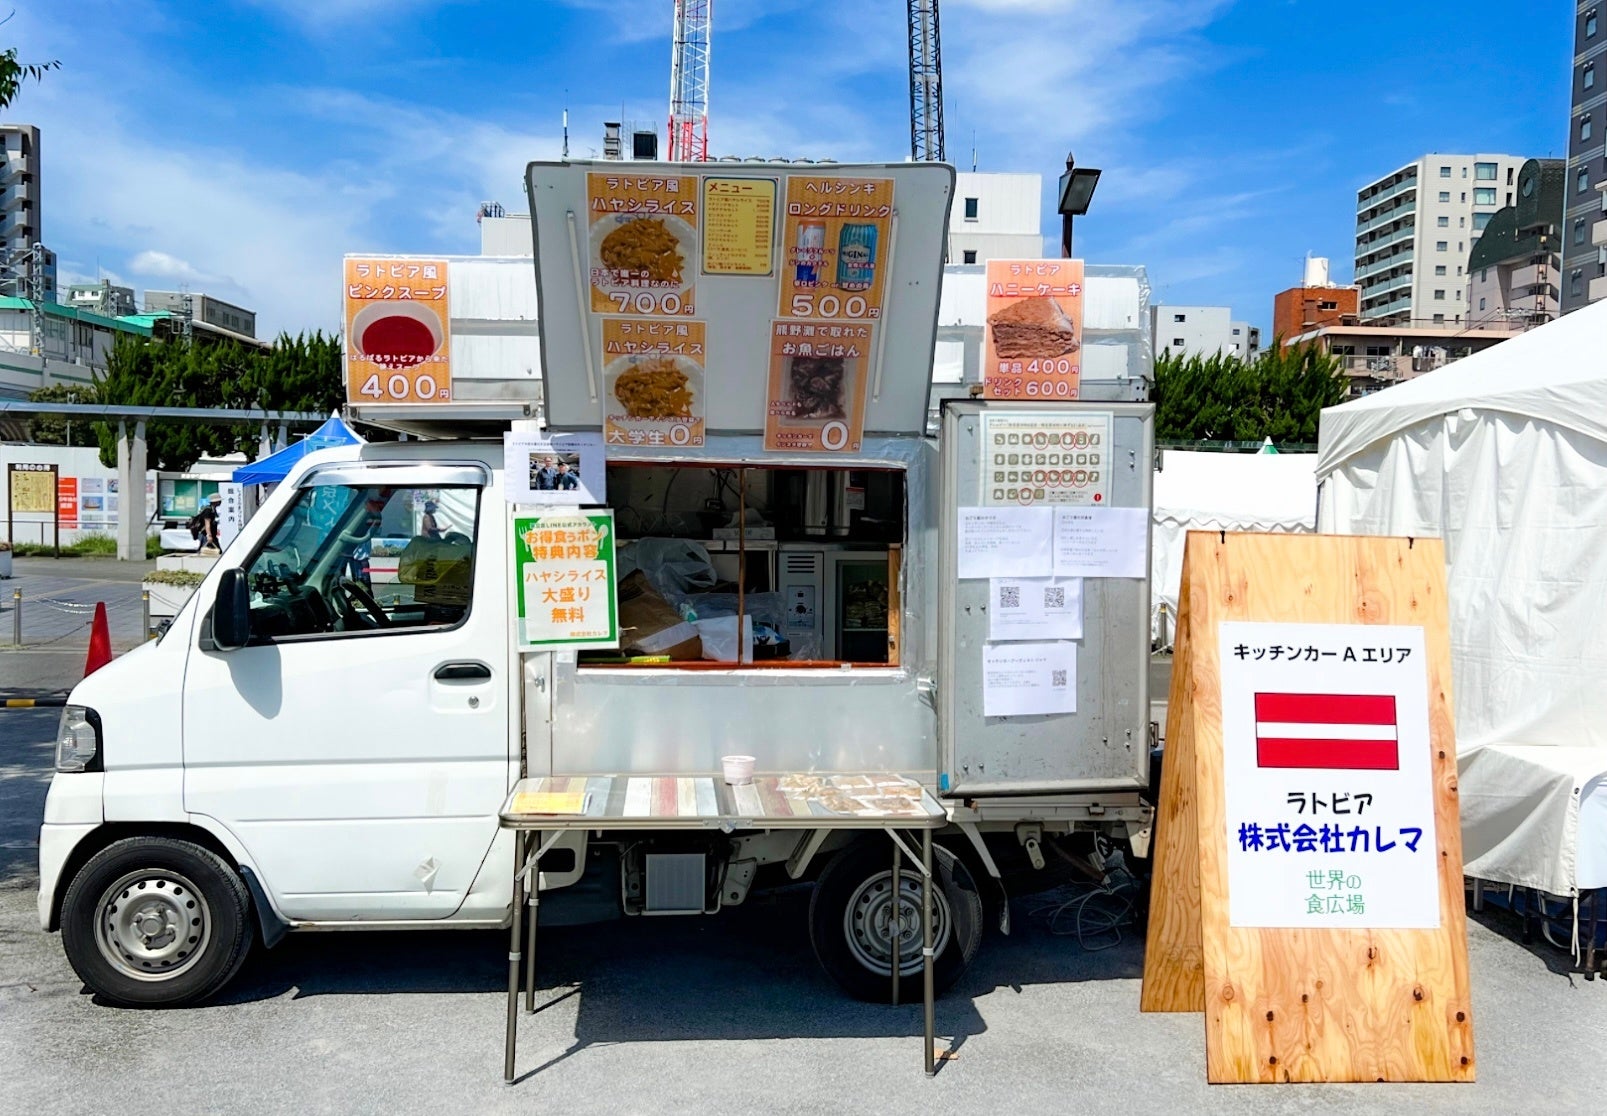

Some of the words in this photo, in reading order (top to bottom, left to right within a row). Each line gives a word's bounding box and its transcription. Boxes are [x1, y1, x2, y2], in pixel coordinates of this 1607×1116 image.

[606, 177, 679, 193] ラトビア風
[708, 182, 753, 194] メニュー
[806, 182, 876, 195] ヘルシンキ
[592, 197, 695, 215] ハヤシライス
[788, 202, 891, 218] ロングドリンク
[848, 250, 865, 259] GIN
[356, 264, 438, 279] ラトビア風
[1010, 264, 1060, 275] ラトビア
[348, 284, 448, 300] ピンクスープ
[991, 283, 1081, 296] ハニーケーキ
[621, 323, 689, 337] ラトビア風
[607, 341, 703, 355] ハヤシライス
[782, 342, 860, 357] お魚ごはん
[984, 378, 1022, 387] ドリンク
[993, 387, 1022, 397] セット
[533, 544, 599, 560] 特典内容
[526, 569, 607, 583] ハヤシライス
[542, 586, 591, 603] 大盛り
[551, 607, 585, 623] 無料
[1234, 643, 1338, 662] キッチンカー
[1343, 647, 1357, 662] A
[1362, 647, 1412, 664] エリア
[1287, 791, 1373, 815] ラトビア
[1238, 822, 1423, 853] 株式会社カレマ
[1305, 869, 1362, 891] 世界の
[1305, 893, 1365, 915] 食広場
